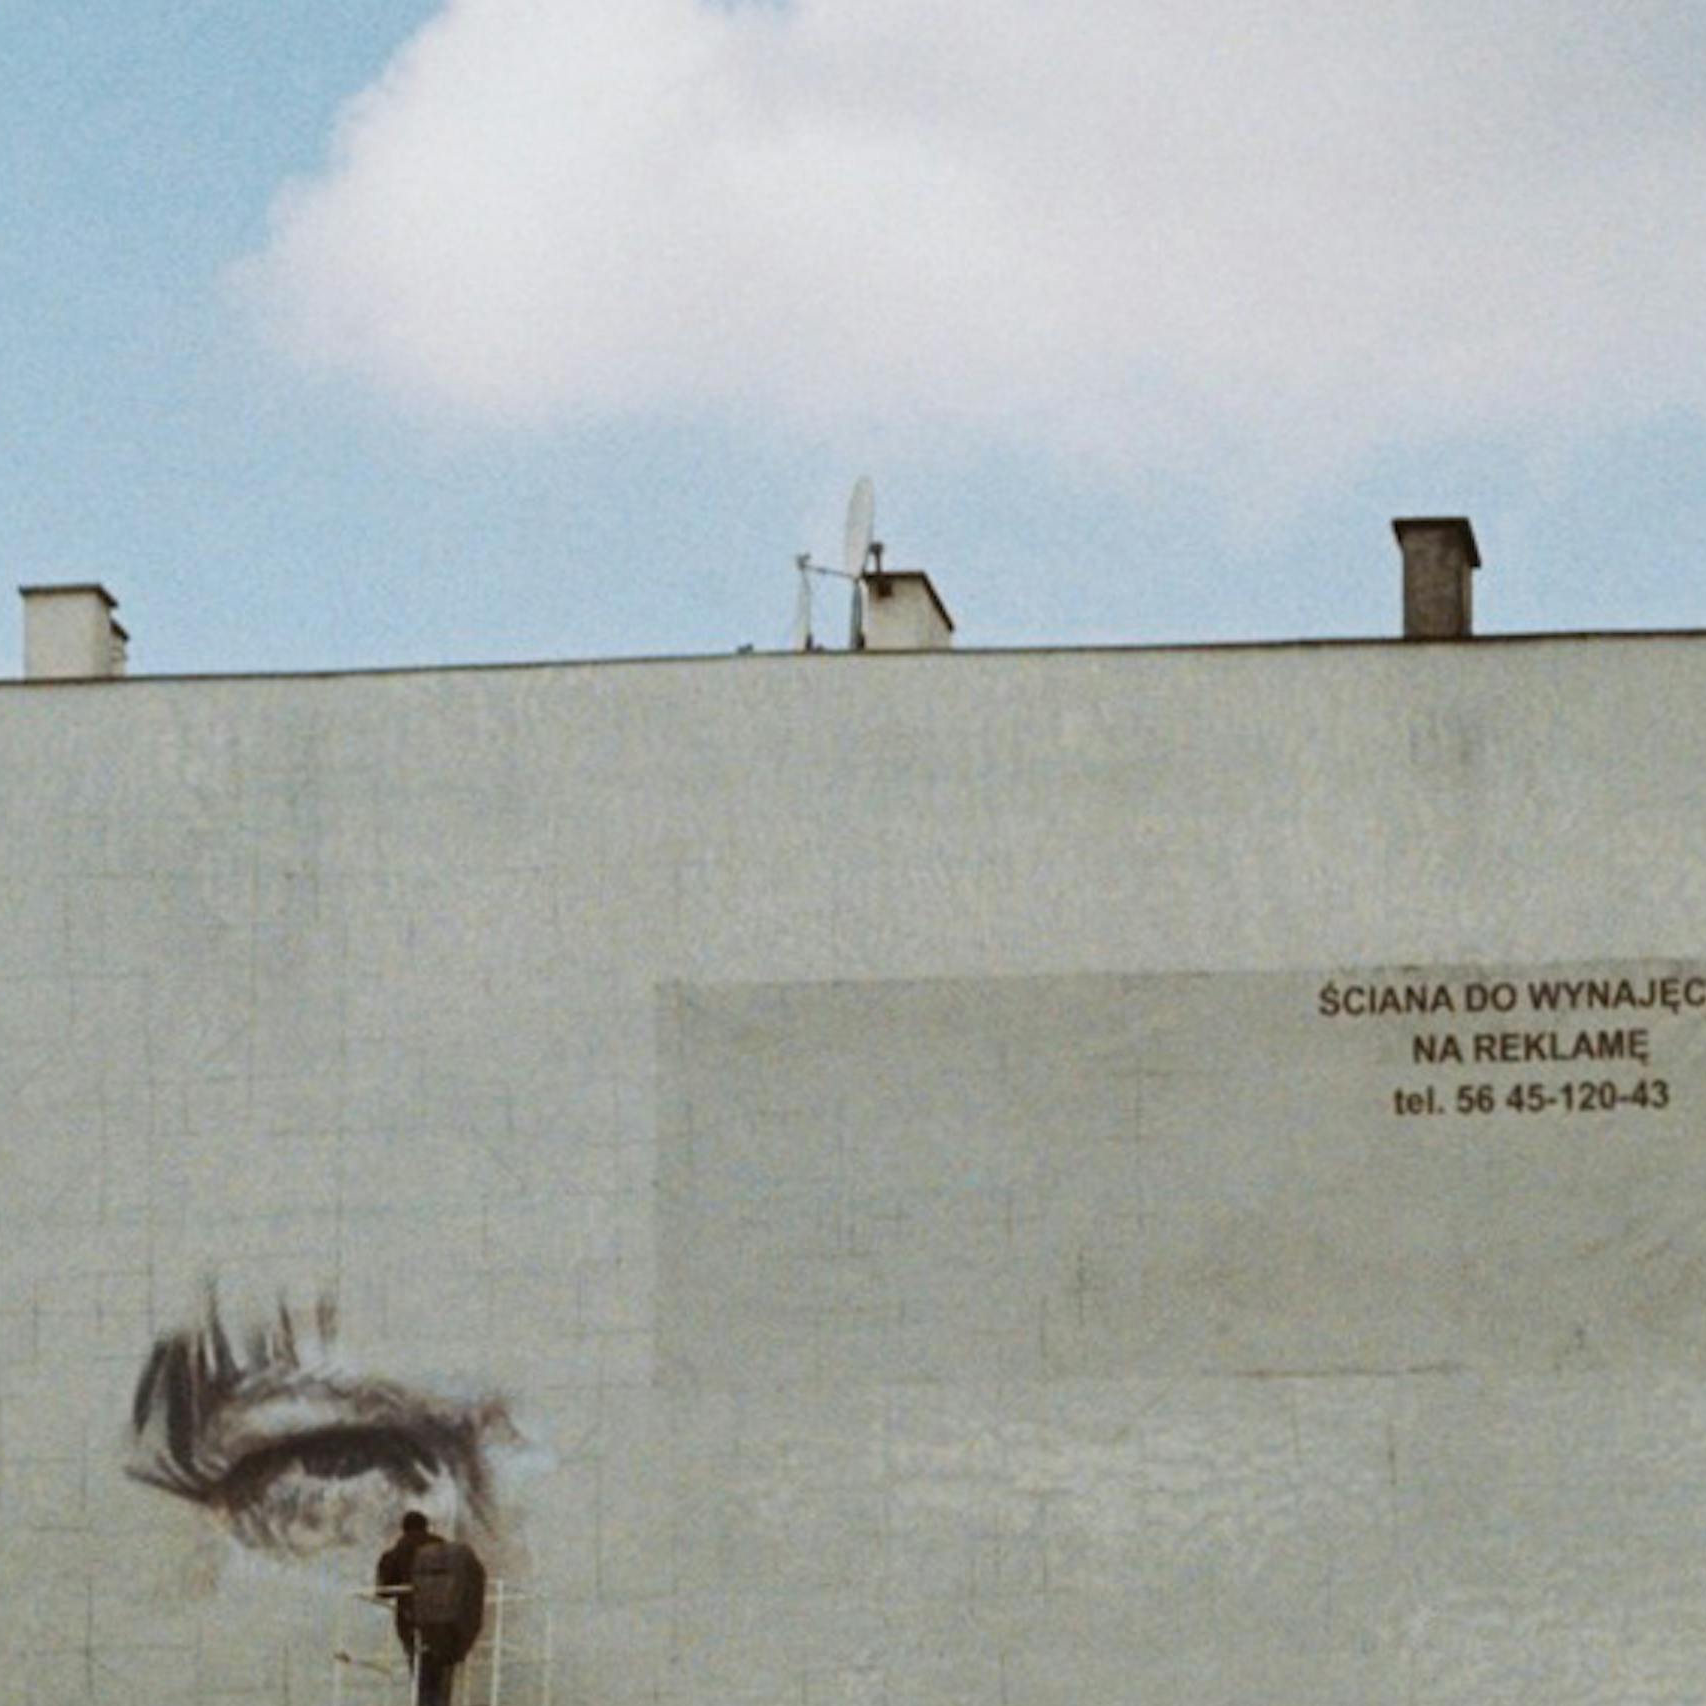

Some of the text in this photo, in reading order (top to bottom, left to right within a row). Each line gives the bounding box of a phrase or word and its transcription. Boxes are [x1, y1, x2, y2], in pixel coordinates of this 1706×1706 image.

[1319, 980, 1456, 1016] ŚCIANA
[1465, 981, 1517, 1013] DO
[1412, 1028, 1649, 1066] NA REKLAMĘ
[1393, 1078, 1671, 1117] tel. 56 45-120-43
